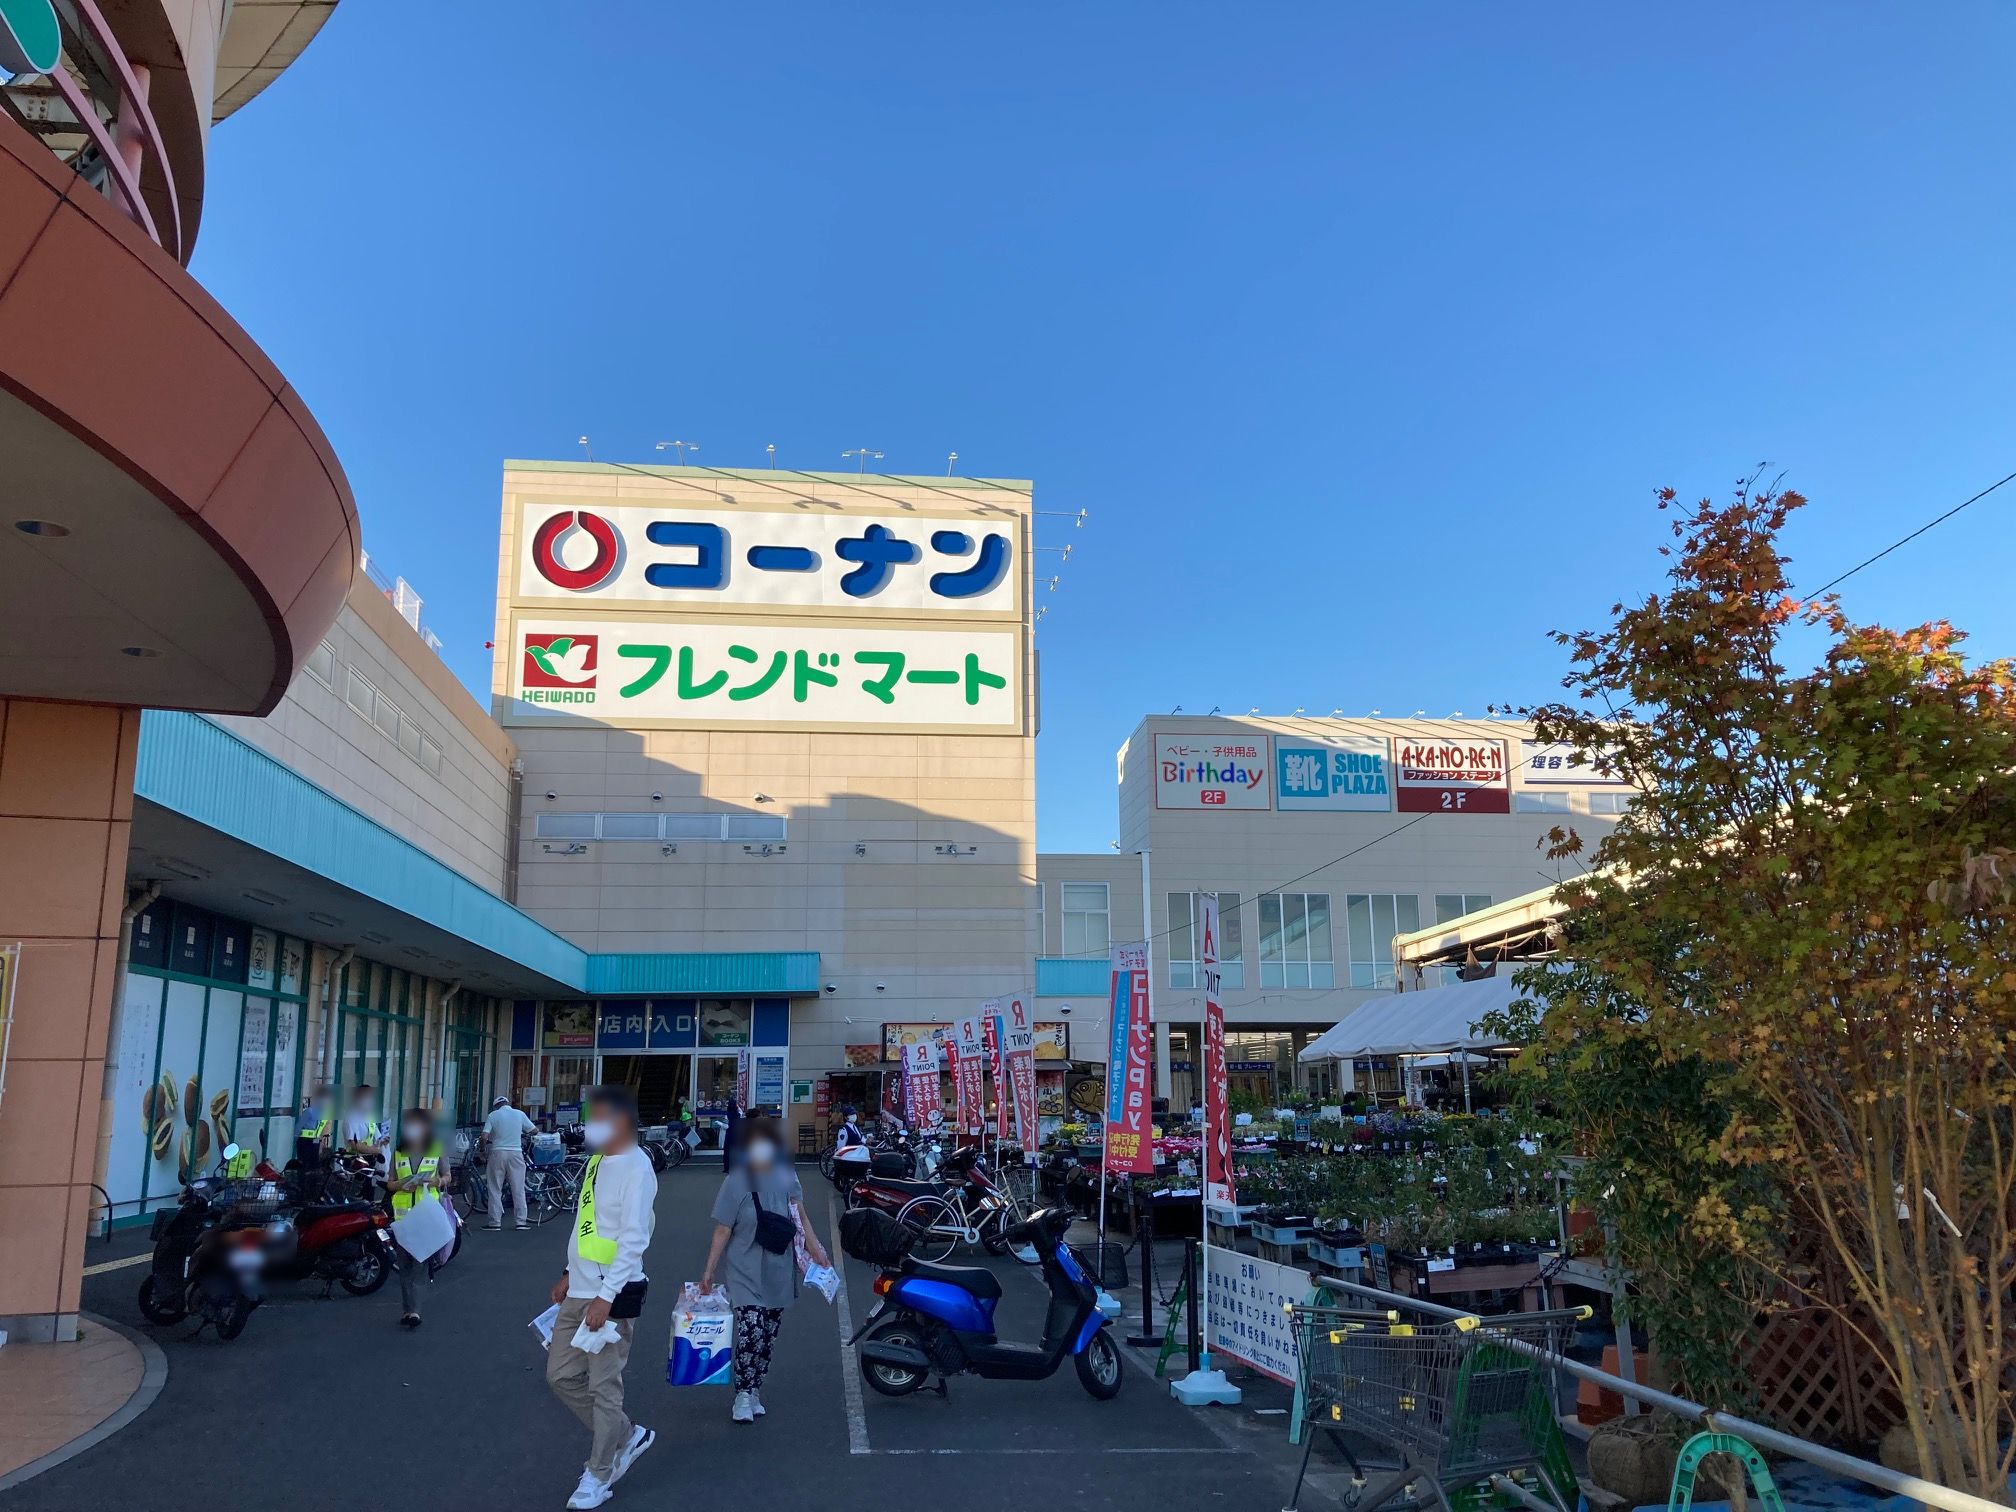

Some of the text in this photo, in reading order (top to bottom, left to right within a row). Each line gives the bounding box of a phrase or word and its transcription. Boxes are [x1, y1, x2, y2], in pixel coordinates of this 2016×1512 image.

[645, 521, 1007, 598] コーナン
[617, 644, 1006, 705] フレンドマート
[522, 690, 596, 703] HEIWADO
[1167, 745, 1257, 758] ベビー・子供用品
[1335, 753, 1383, 773] SHOE
[1161, 761, 1263, 789] Birthday
[1285, 754, 1323, 791] 靴
[1408, 771, 1496, 780] ファッション ステージ
[1331, 774, 1387, 794] PLAZA
[1204, 791, 1222, 803] 2F
[1441, 792, 1466, 808] 2F
[603, 1014, 691, 1033] 店内入口
[1241, 1263, 1260, 1281] お願い
[686, 1326, 726, 1335] エリエール
